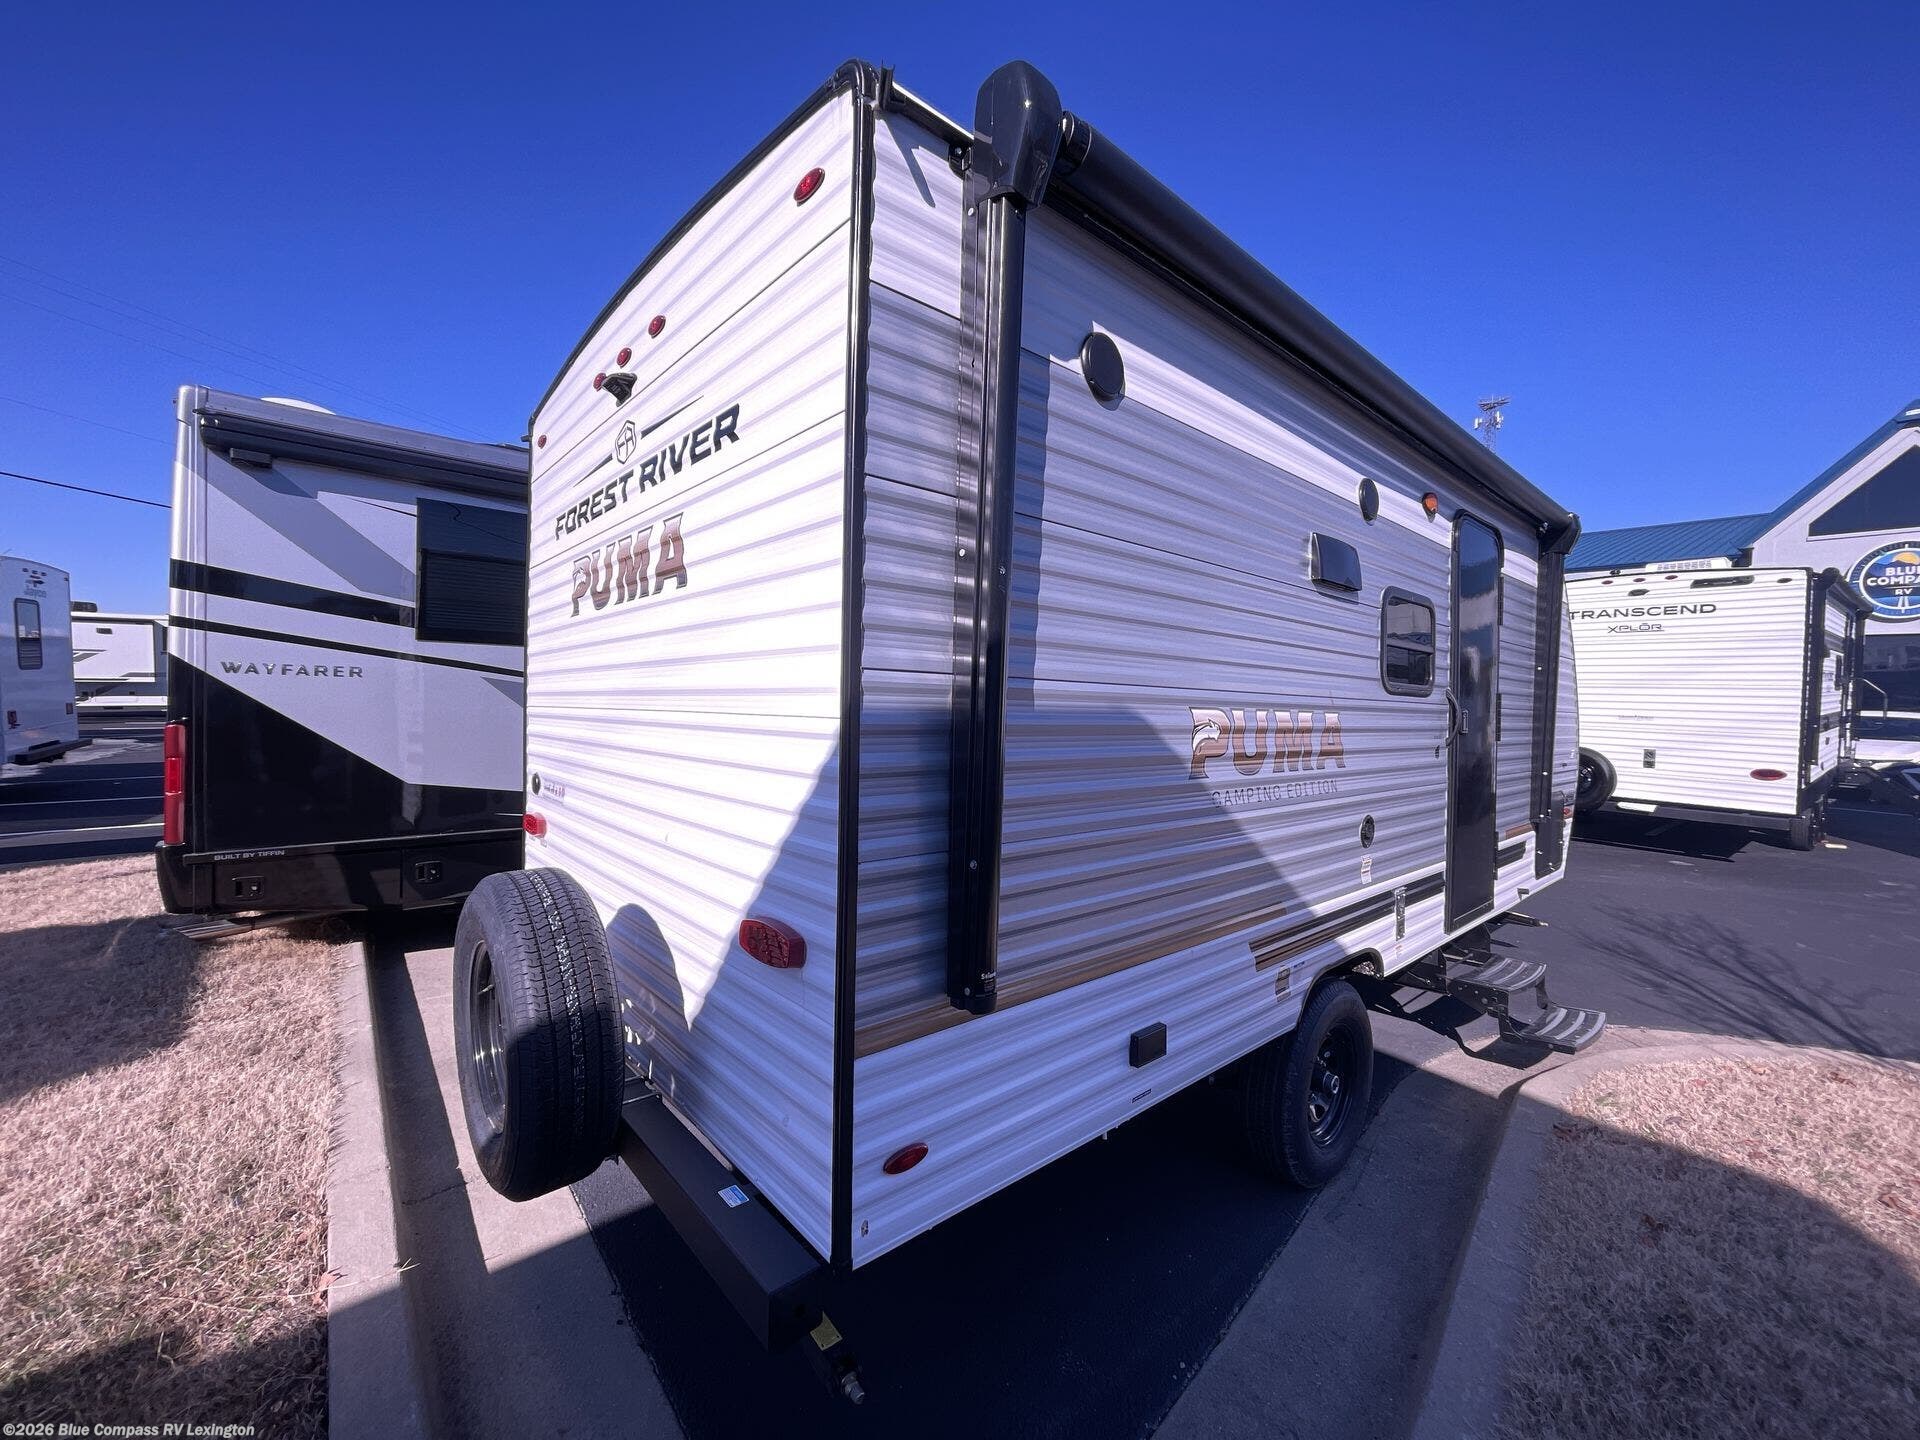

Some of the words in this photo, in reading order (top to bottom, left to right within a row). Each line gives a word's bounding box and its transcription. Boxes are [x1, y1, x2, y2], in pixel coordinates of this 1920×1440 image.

[555, 468, 634, 541] FOREST
[639, 403, 740, 493] RIVER
[570, 512, 688, 617] PUMA
[1895, 588, 1913, 596] RV
[1569, 604, 1717, 620] TRANSCEND
[220, 661, 363, 678] WAYFARER
[1188, 706, 1346, 780] PUMA
[1211, 785, 1281, 808] CAMPING
[1287, 779, 1338, 800] EDITION
[214, 853, 241, 861] BUILT
